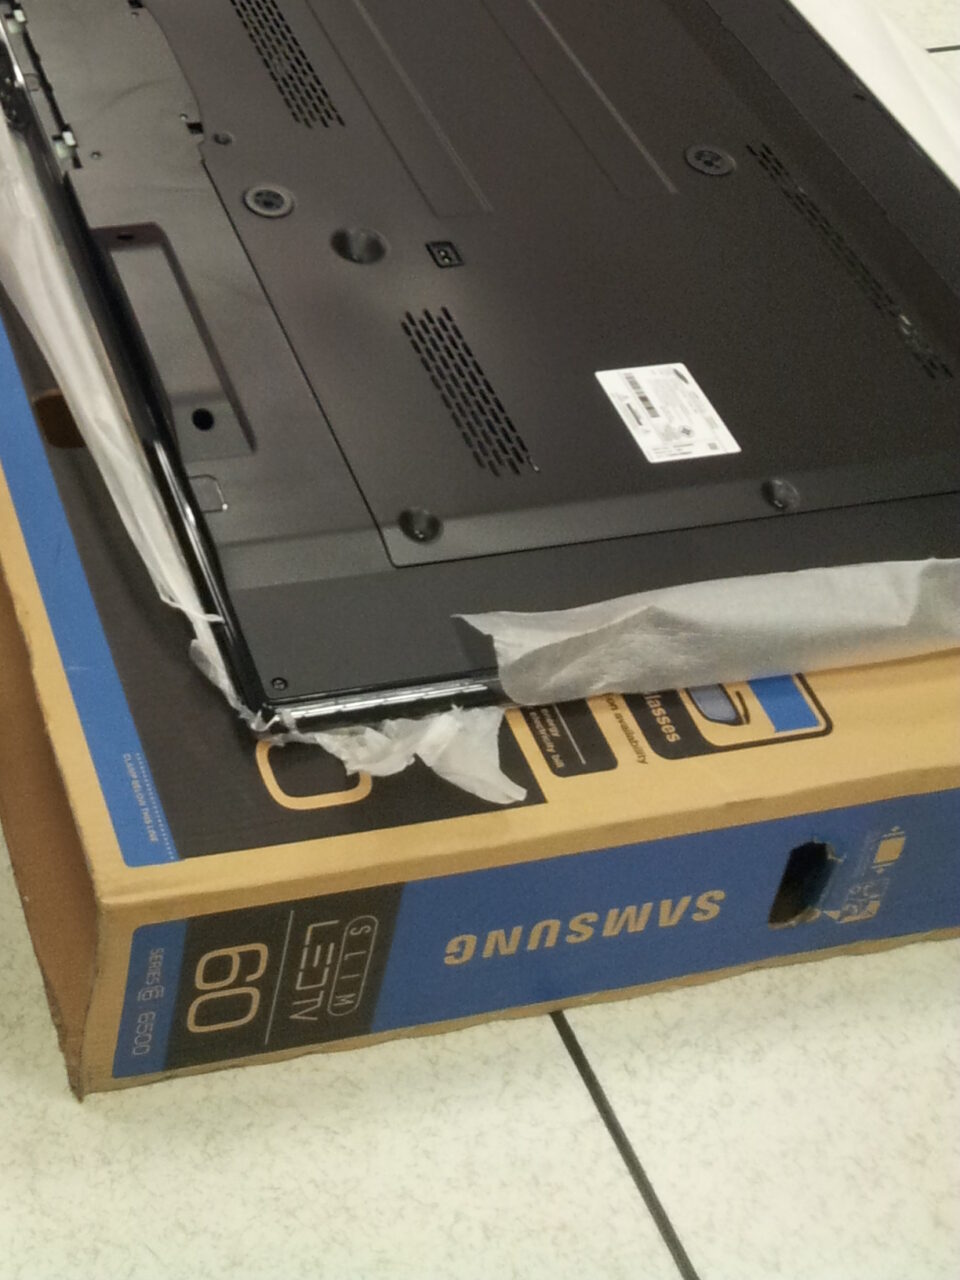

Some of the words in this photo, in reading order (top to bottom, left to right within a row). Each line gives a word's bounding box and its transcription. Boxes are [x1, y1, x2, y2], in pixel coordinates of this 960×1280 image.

[643, 694, 681, 743] lasses
[443, 889, 726, 966] SAMSUNG
[145, 947, 165, 986] SERIES
[186, 942, 269, 1033] 60
[332, 924, 372, 1007] SLIM
[132, 1011, 157, 1056] 6500
